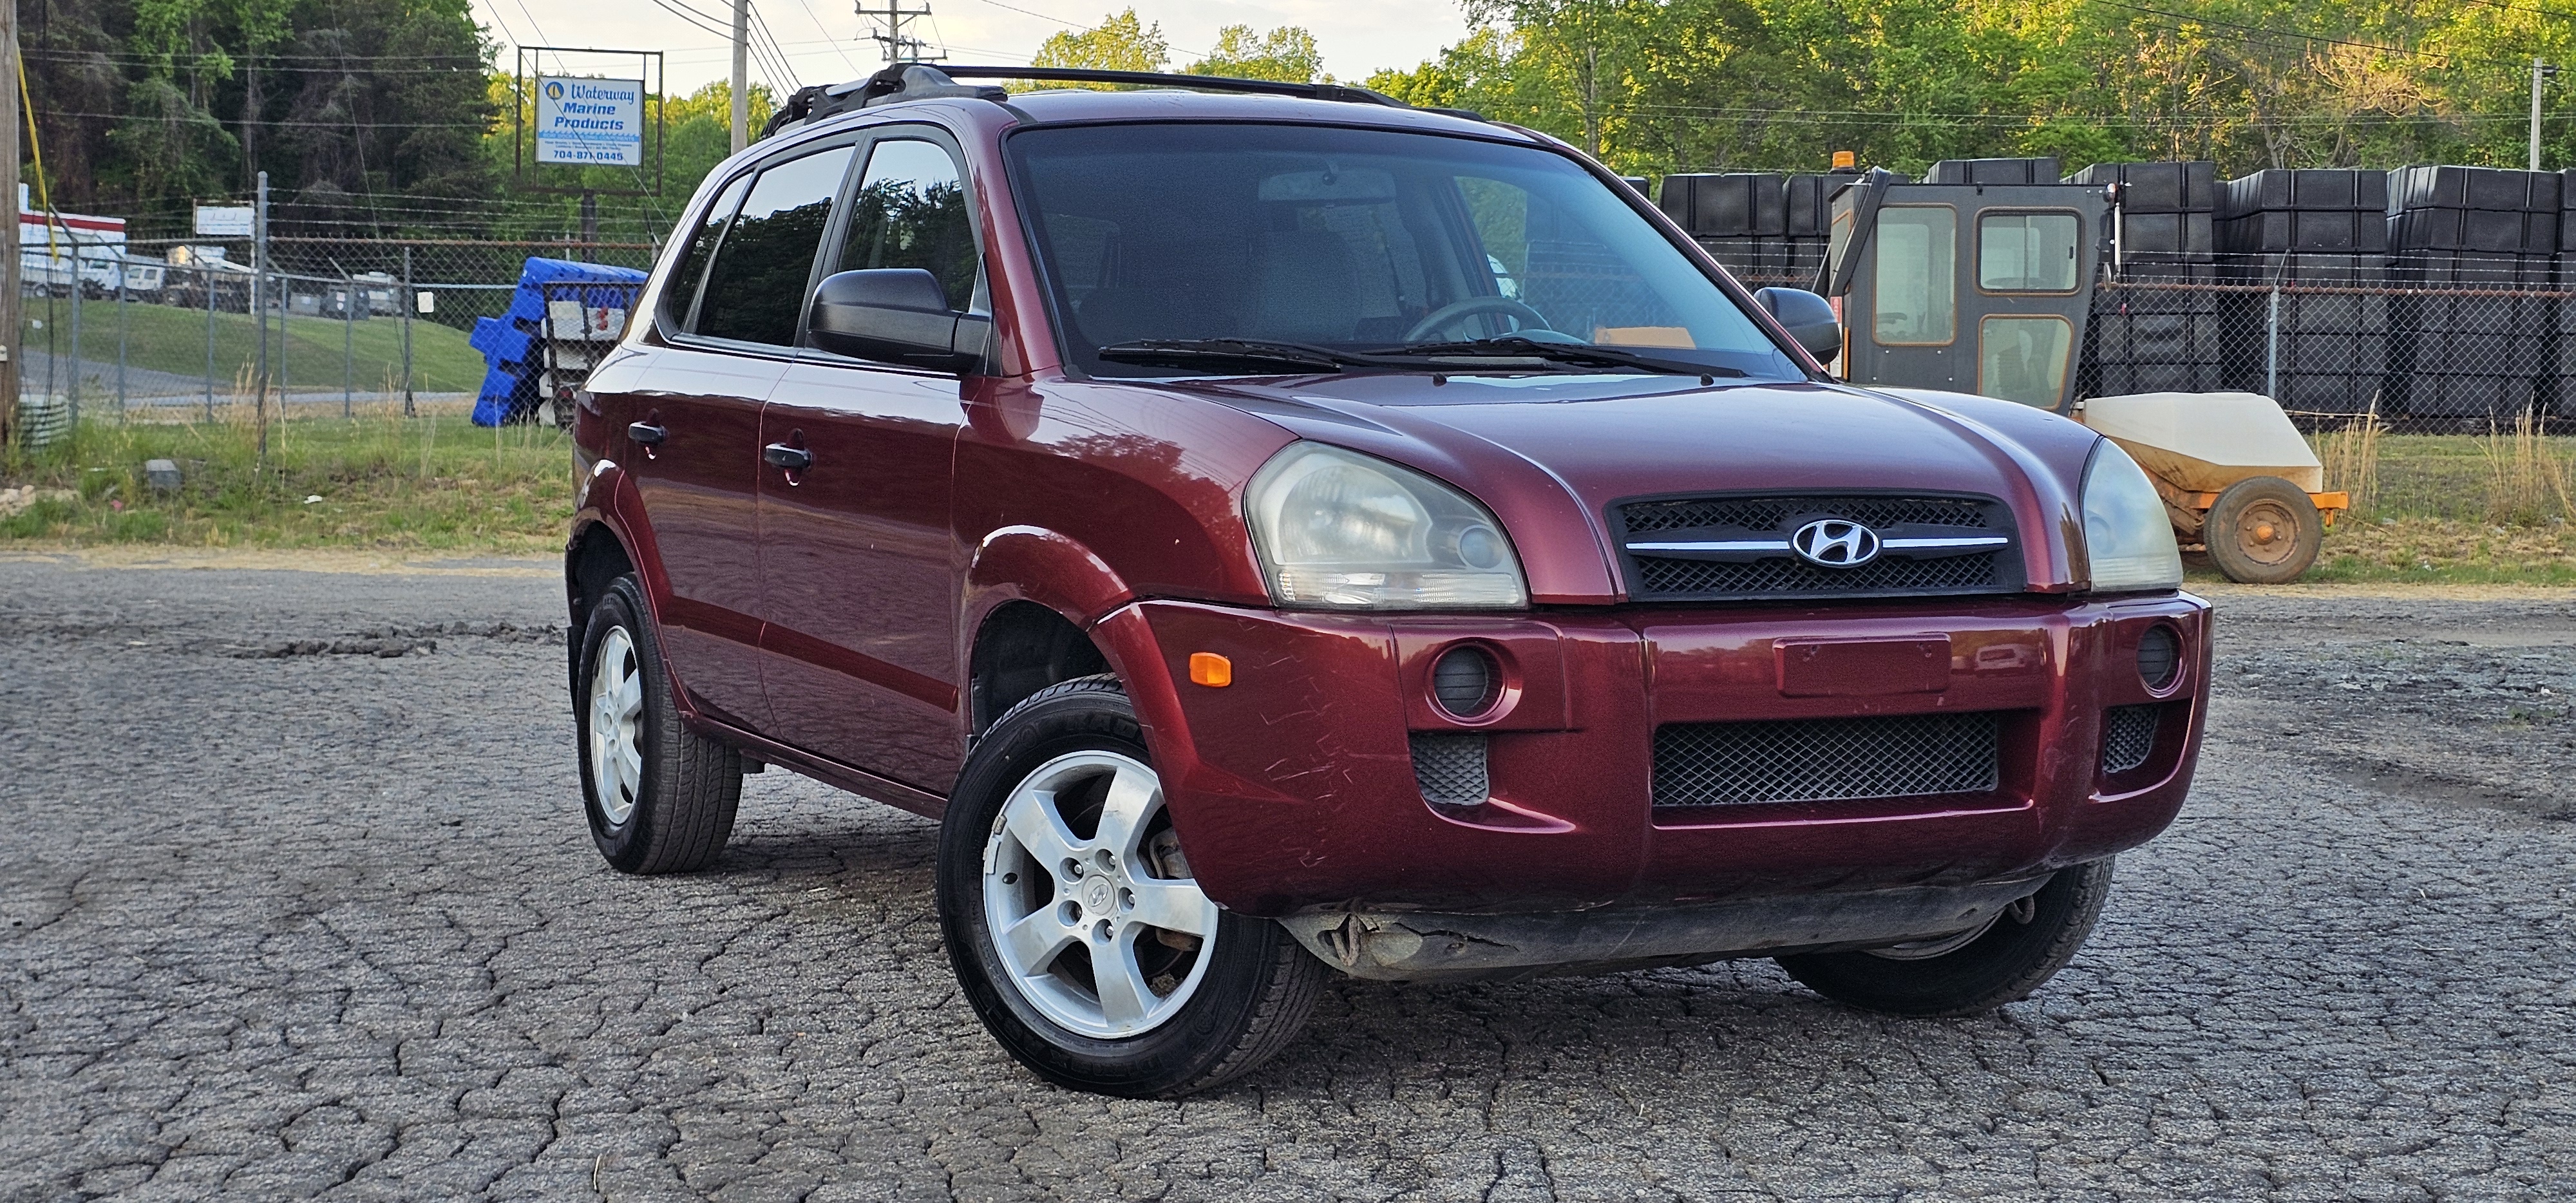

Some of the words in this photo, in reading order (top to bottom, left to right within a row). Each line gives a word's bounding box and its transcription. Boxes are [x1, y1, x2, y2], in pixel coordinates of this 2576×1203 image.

[571, 83, 634, 104] Waterway
[564, 102, 616, 115] Marine
[554, 117, 624, 130] Products
